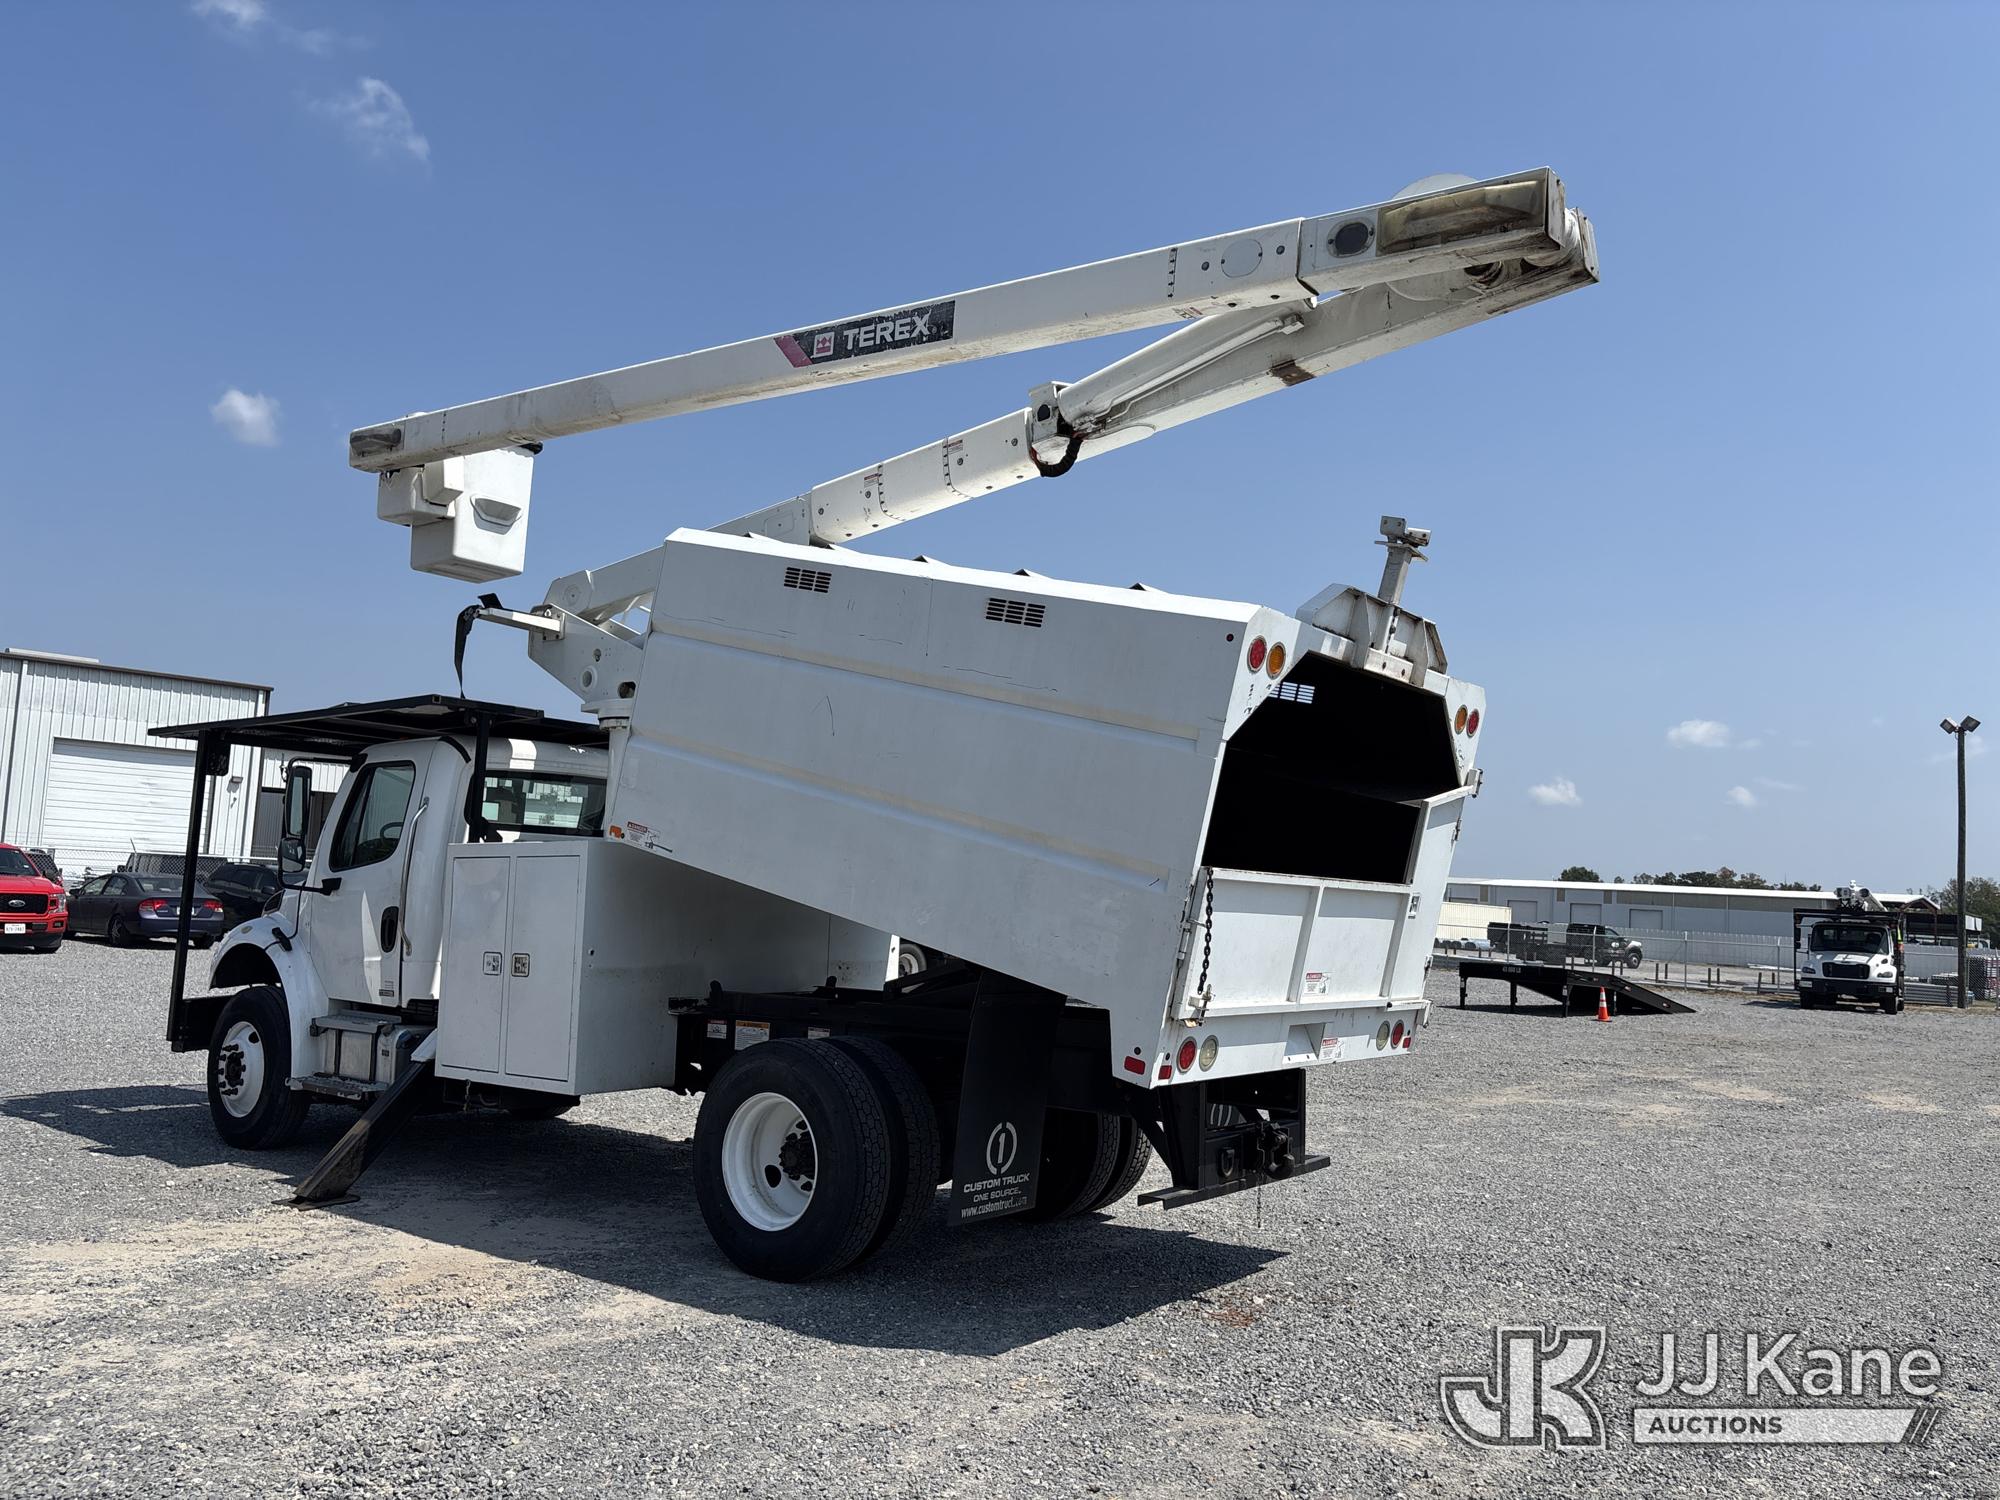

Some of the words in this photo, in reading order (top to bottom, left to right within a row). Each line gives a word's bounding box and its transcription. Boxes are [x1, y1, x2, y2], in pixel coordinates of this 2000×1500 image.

[843, 309, 932, 350] TEREX
[963, 1178, 1001, 1193] CUSTOM
[1002, 1172, 1031, 1186] TRUCK
[973, 1192, 989, 1203] ONE
